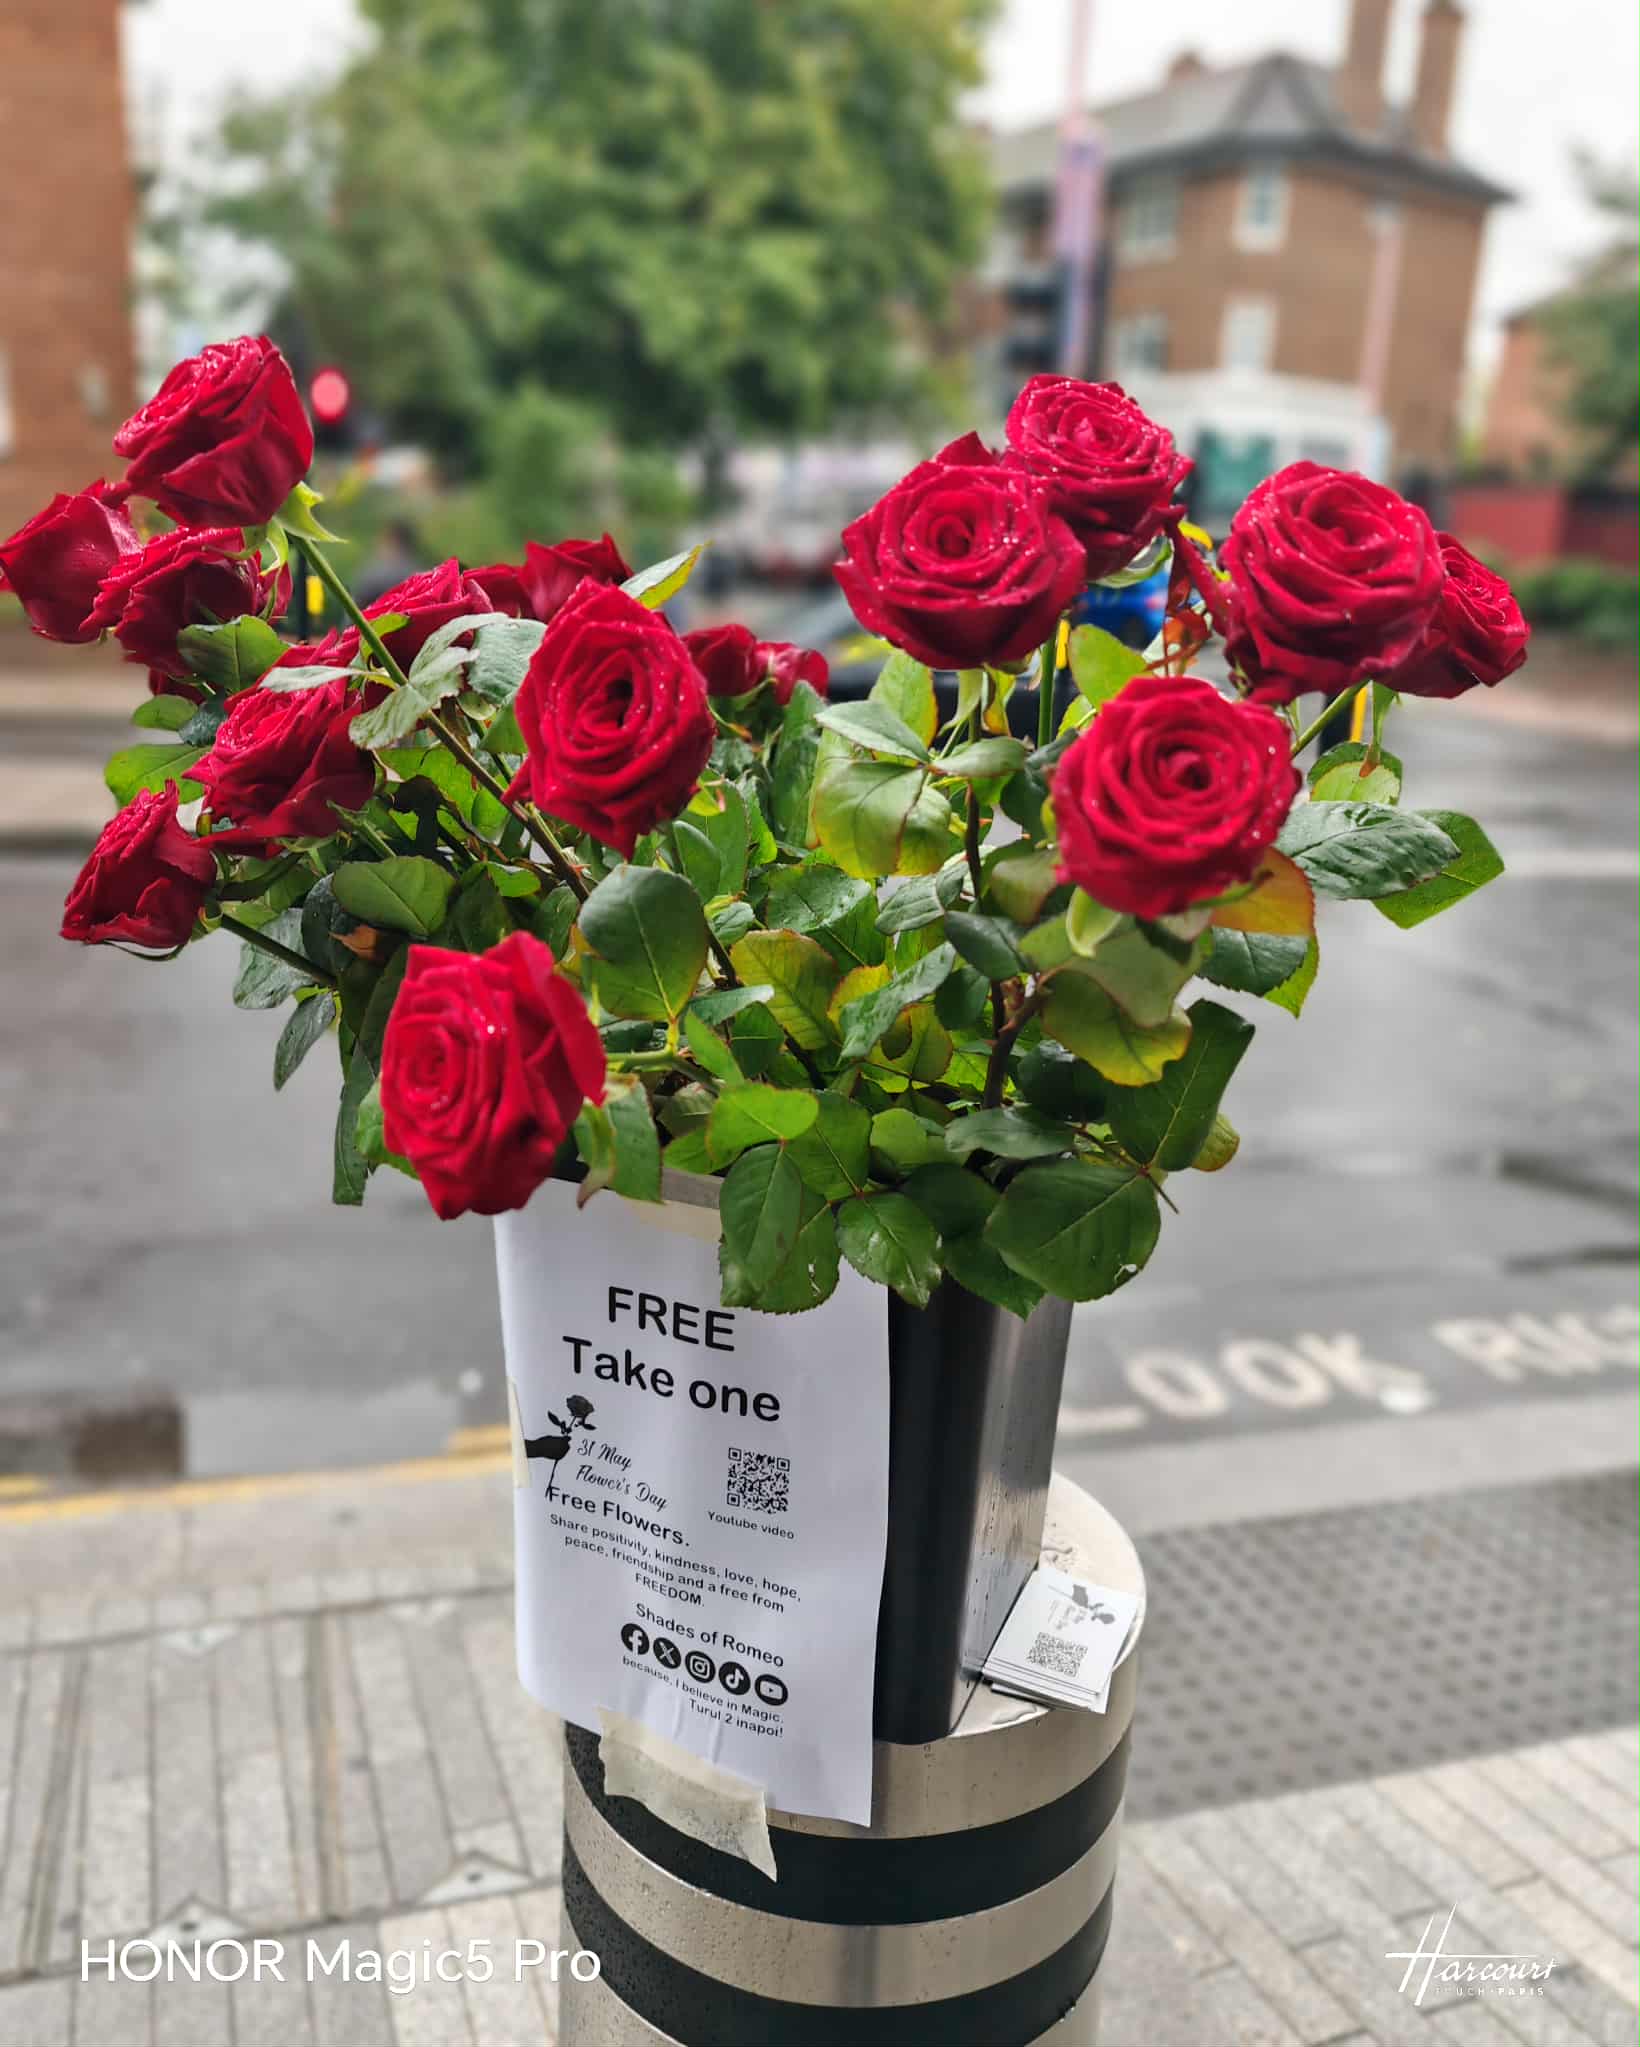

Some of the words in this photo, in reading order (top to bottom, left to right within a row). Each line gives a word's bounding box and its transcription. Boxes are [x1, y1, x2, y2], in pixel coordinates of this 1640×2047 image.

[608, 1286, 735, 1352] FREE
[562, 1335, 674, 1398] Take
[689, 1379, 780, 1422] one
[577, 1439, 596, 1456] 31
[598, 1443, 632, 1471] May
[548, 1486, 596, 1513] Free
[603, 1500, 690, 1546] Flowers.
[576, 1464, 631, 1495] Flower's
[635, 1482, 668, 1512] Day
[708, 1511, 757, 1530] Youtube
[761, 1525, 794, 1539] video
[550, 1514, 589, 1533] Share
[592, 1528, 651, 1557] positivity,
[655, 1549, 720, 1577] kindness,
[725, 1568, 758, 1588] love,
[763, 1578, 801, 1602] hope,
[565, 1535, 609, 1557] peace,
[612, 1548, 675, 1582] friendship
[678, 1574, 704, 1590] and
[708, 1583, 716, 1593] a
[721, 1584, 749, 1601] free
[752, 1593, 785, 1614] from
[635, 1573, 705, 1607] FREEDOM.
[635, 1603, 695, 1638] Shades
[700, 1631, 718, 1645] of
[723, 1634, 784, 1667] Romeo
[622, 1656, 673, 1686] because,
[675, 1677, 680, 1689] I
[682, 1679, 724, 1706] believe
[727, 1698, 738, 1711] in
[688, 1698, 722, 1720] Turul
[725, 1713, 734, 1725] 2
[737, 1718, 783, 1738] inapoi!
